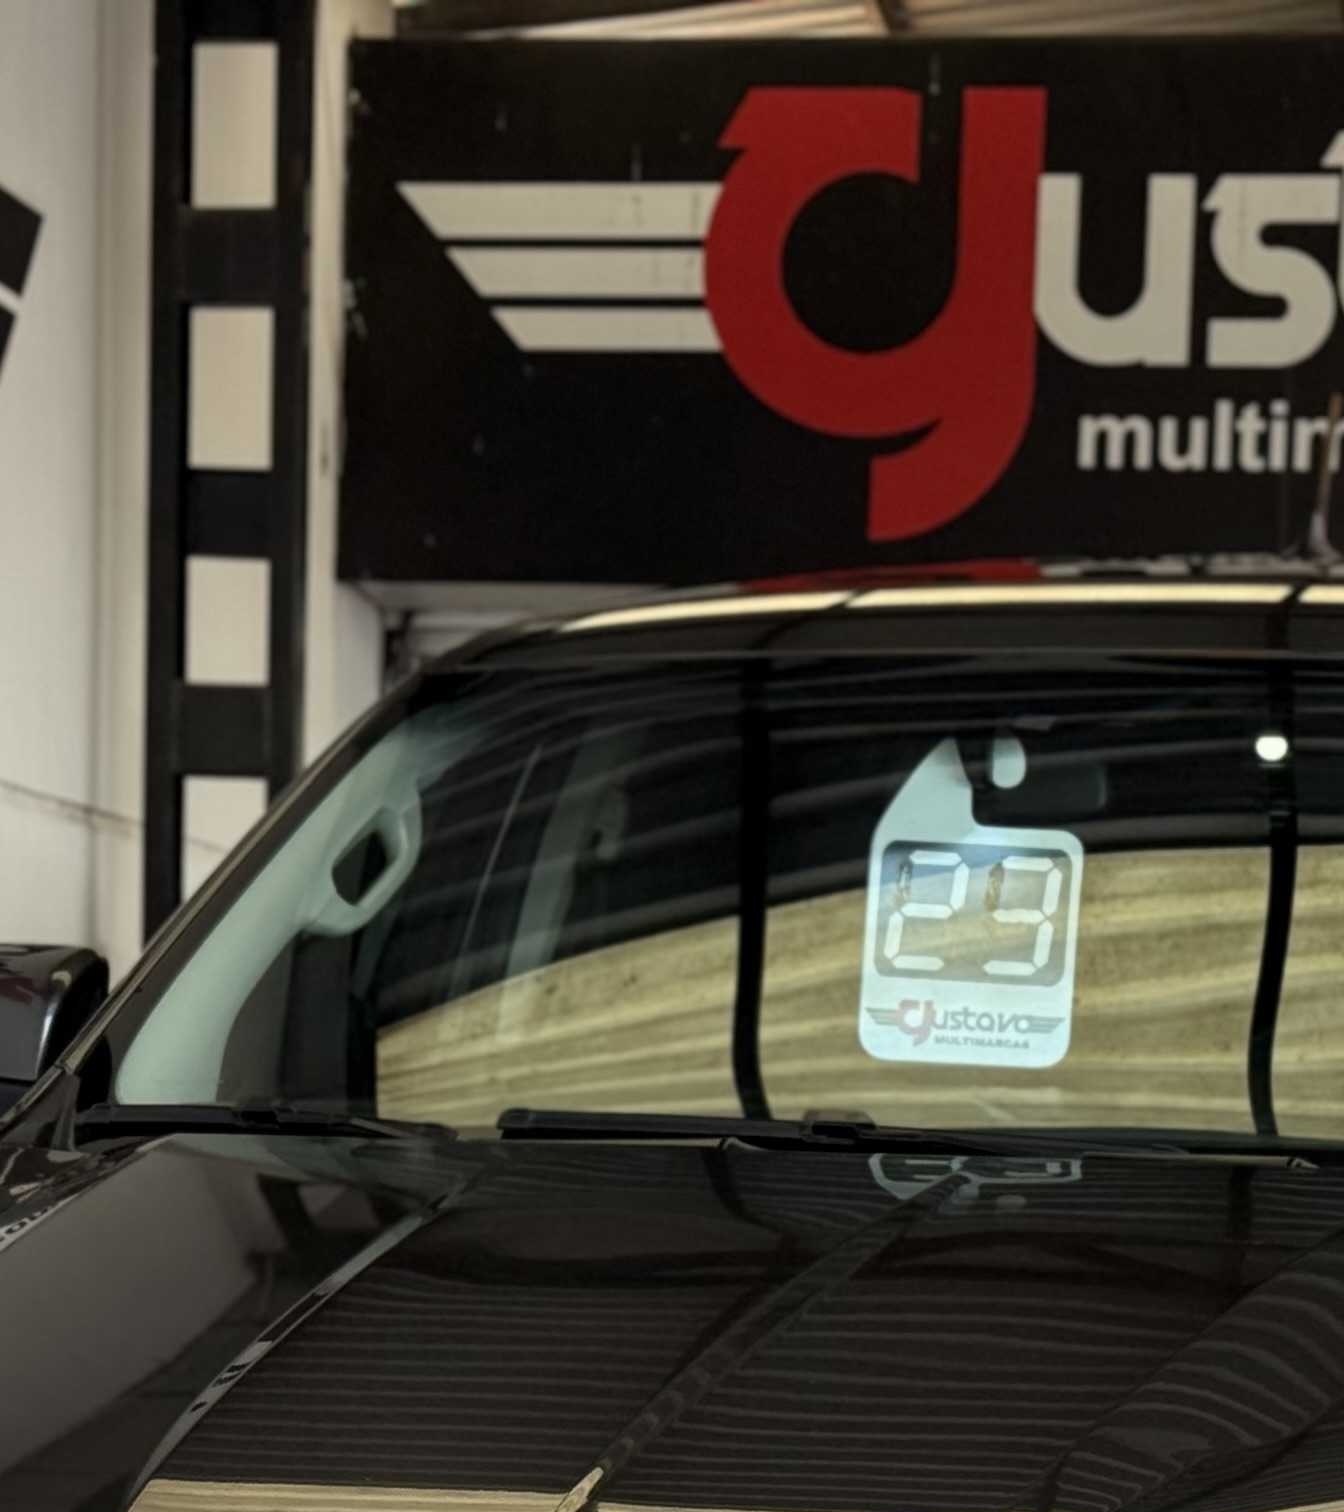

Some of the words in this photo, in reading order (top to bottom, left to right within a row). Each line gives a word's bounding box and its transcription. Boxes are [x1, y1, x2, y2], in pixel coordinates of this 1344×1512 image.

[883, 850, 1063, 977] 23
[896, 999, 1032, 1047] gustavo
[935, 1035, 1030, 1049] MULTIMARCAS
